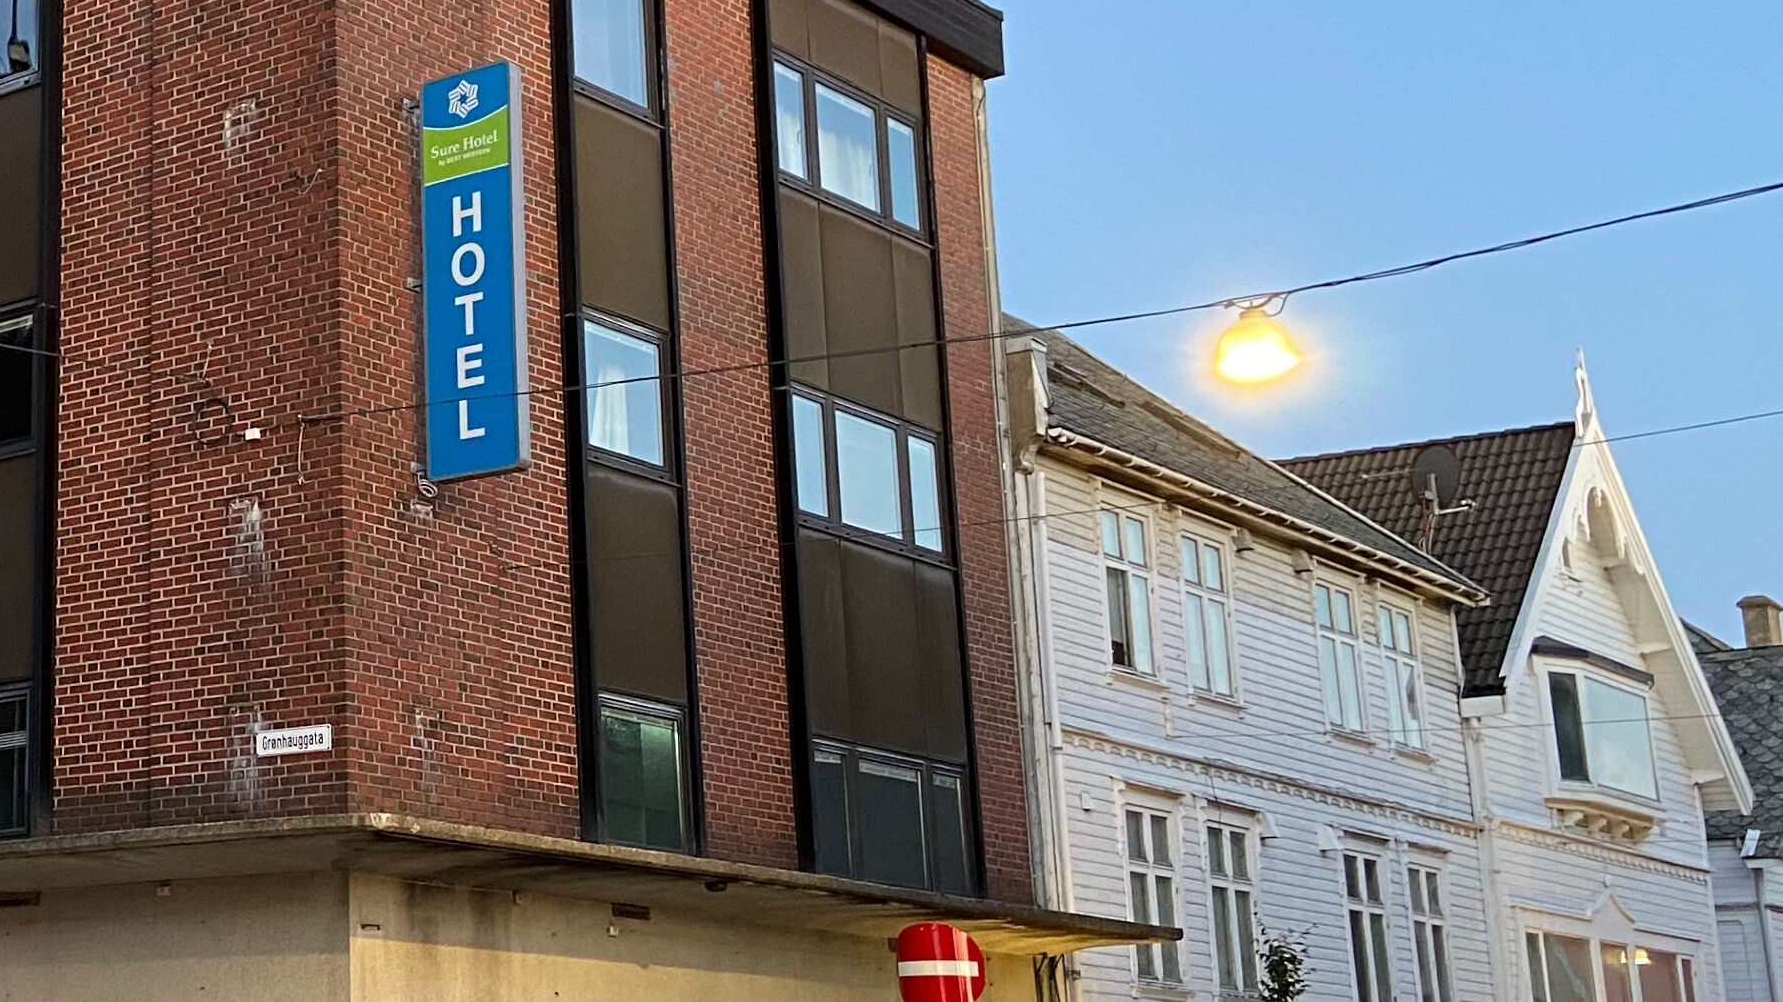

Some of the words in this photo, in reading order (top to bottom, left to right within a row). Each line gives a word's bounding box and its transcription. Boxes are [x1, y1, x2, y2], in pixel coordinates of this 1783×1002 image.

[430, 143, 460, 159] Sure
[463, 129, 498, 151] Hotel
[451, 191, 486, 440] HOTEL
[262, 731, 324, 750] Grønhauggata
